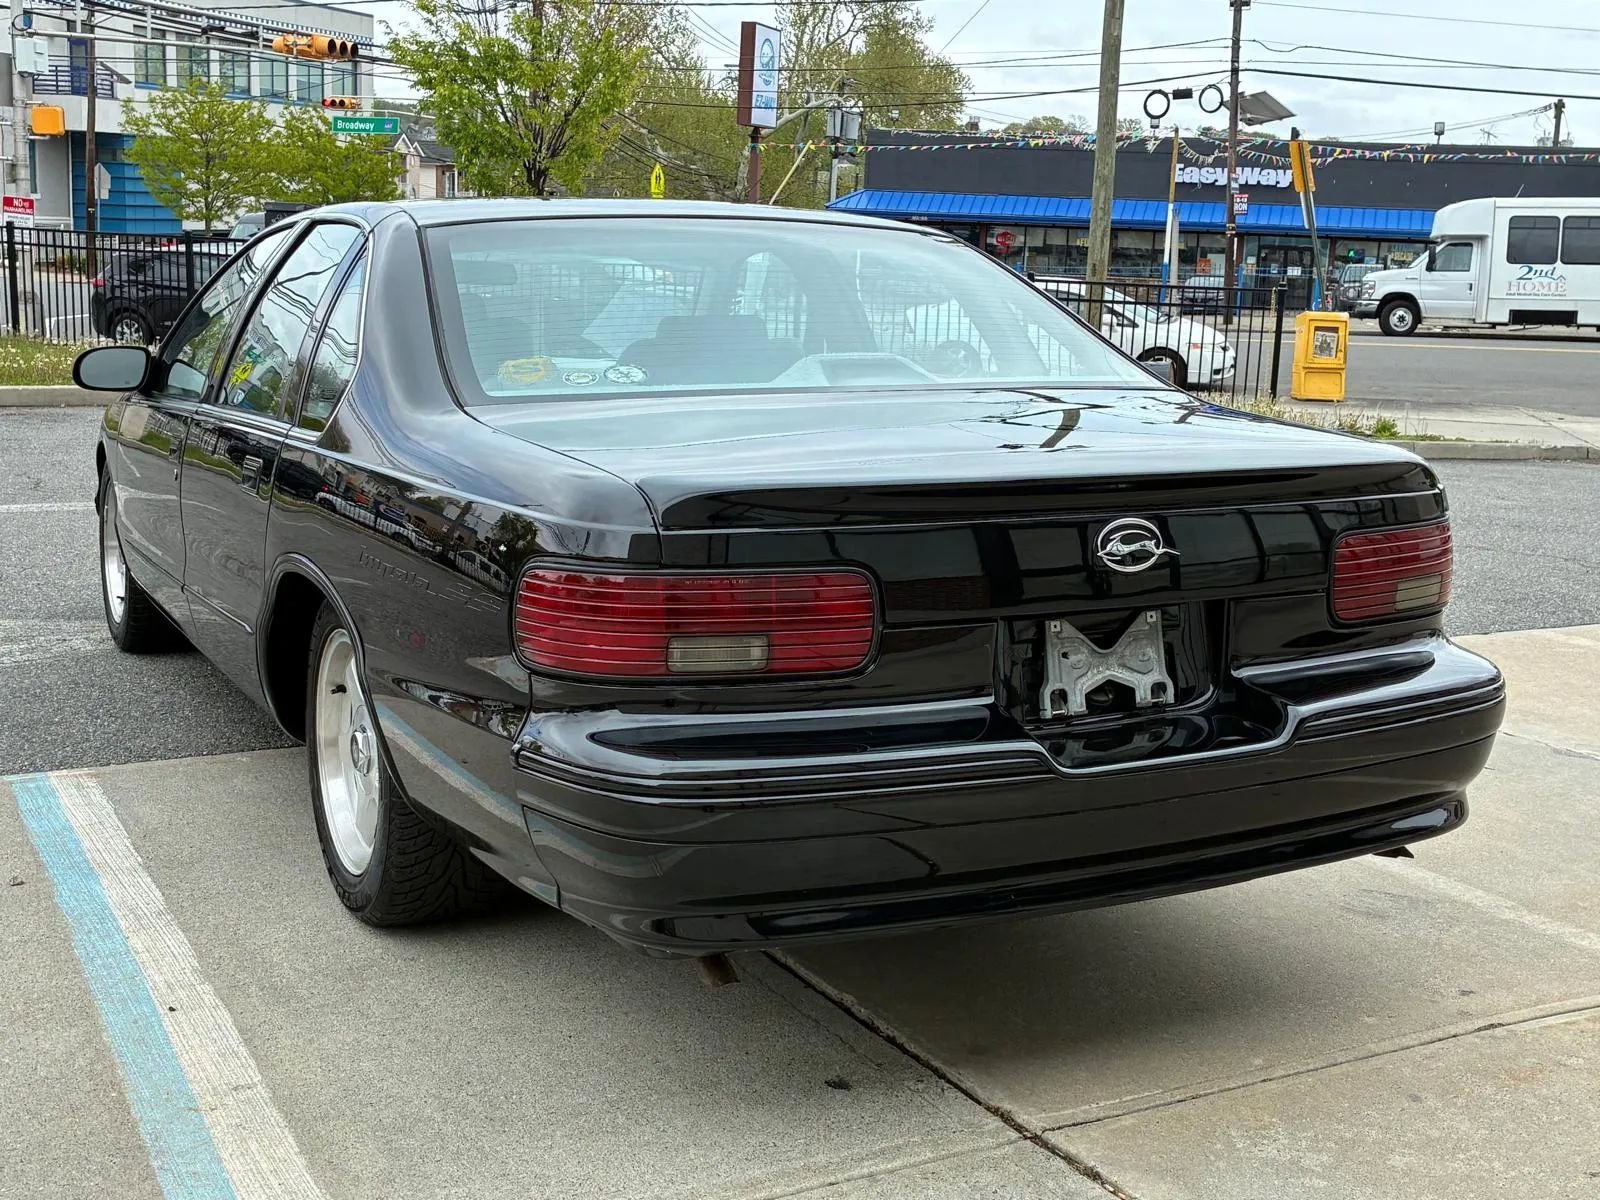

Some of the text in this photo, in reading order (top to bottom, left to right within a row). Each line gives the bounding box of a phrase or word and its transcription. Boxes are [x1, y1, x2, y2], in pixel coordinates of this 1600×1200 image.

[337, 120, 375, 132] Broadway
[1516, 265, 1557, 280] 2nd
[1507, 280, 1567, 293] HOME
